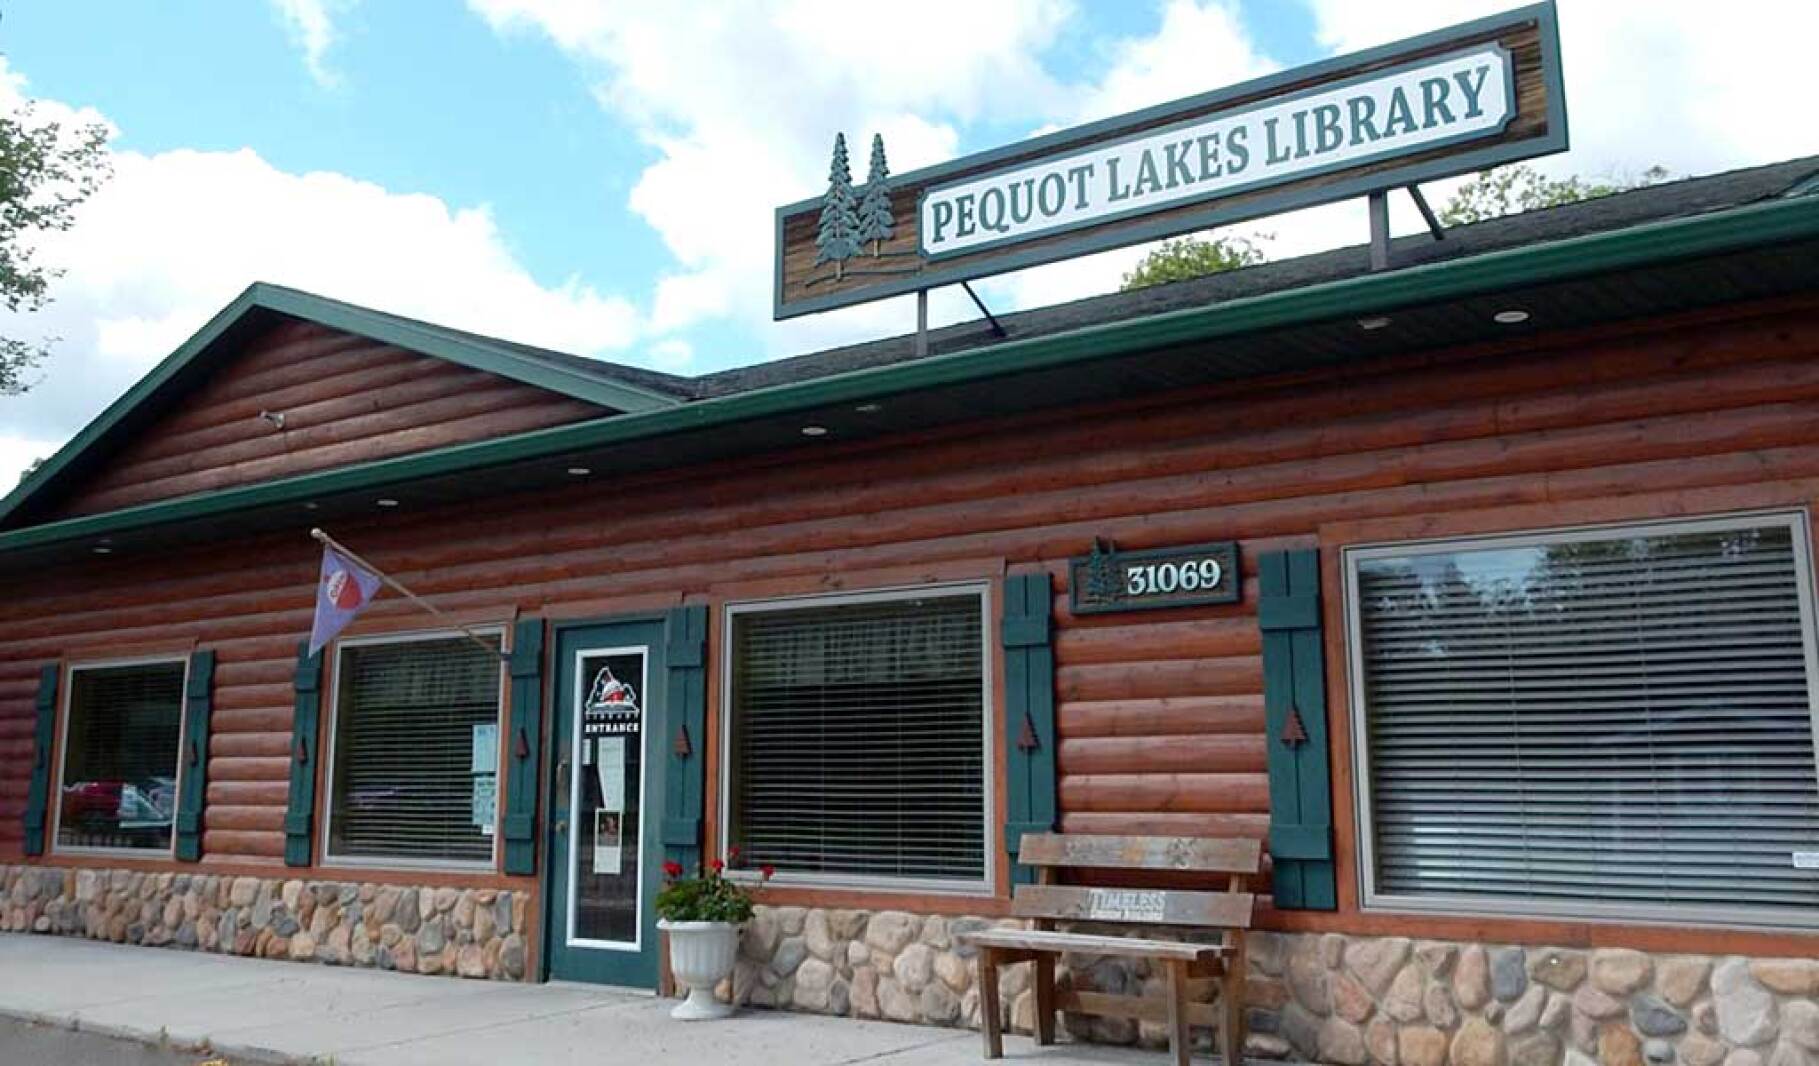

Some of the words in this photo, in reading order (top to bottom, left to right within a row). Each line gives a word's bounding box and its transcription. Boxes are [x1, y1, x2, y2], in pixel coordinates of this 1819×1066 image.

[931, 165, 1095, 243] PEQUOT
[1106, 126, 1248, 202] LAKES
[1264, 65, 1491, 166] LIBRARY
[1127, 559, 1221, 595] 31069
